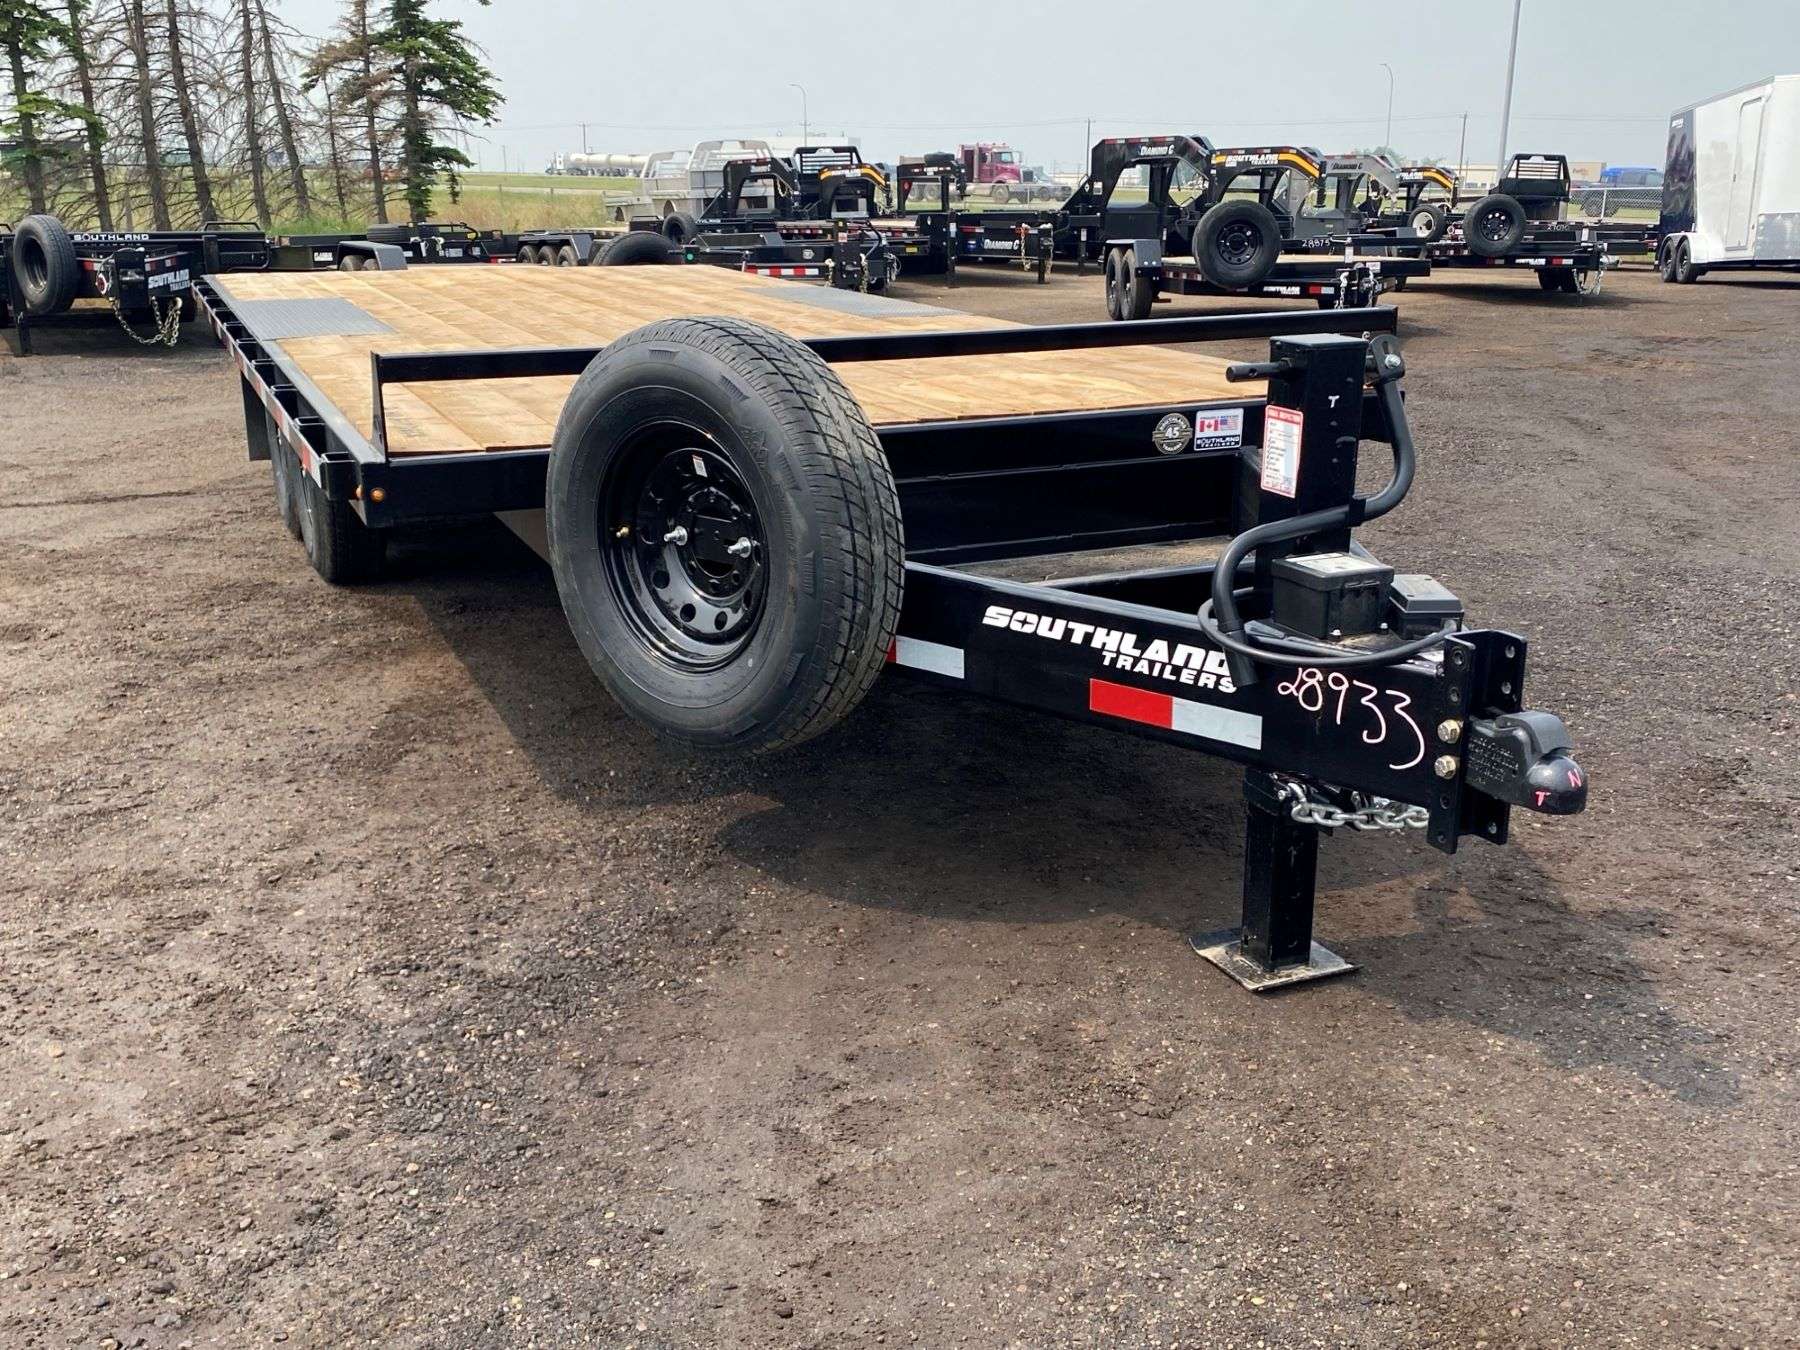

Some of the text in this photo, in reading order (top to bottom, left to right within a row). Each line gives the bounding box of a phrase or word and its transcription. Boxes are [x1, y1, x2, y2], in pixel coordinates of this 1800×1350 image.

[1226, 154, 1279, 163] SOUTHLAND
[73, 233, 150, 241] SOUTHLAND
[983, 239, 1020, 250] DIAMOND C
[147, 268, 190, 290] SOUTHLAND
[169, 280, 191, 292] TRAILERS
[1327, 394, 1340, 408] T
[1164, 426, 1181, 439] 45
[1196, 436, 1240, 445] SOUTHLAND
[982, 605, 1231, 676] SOUTHLAND
[1102, 651, 1238, 693] TRAILERS
[1277, 667, 1425, 770] 28933
